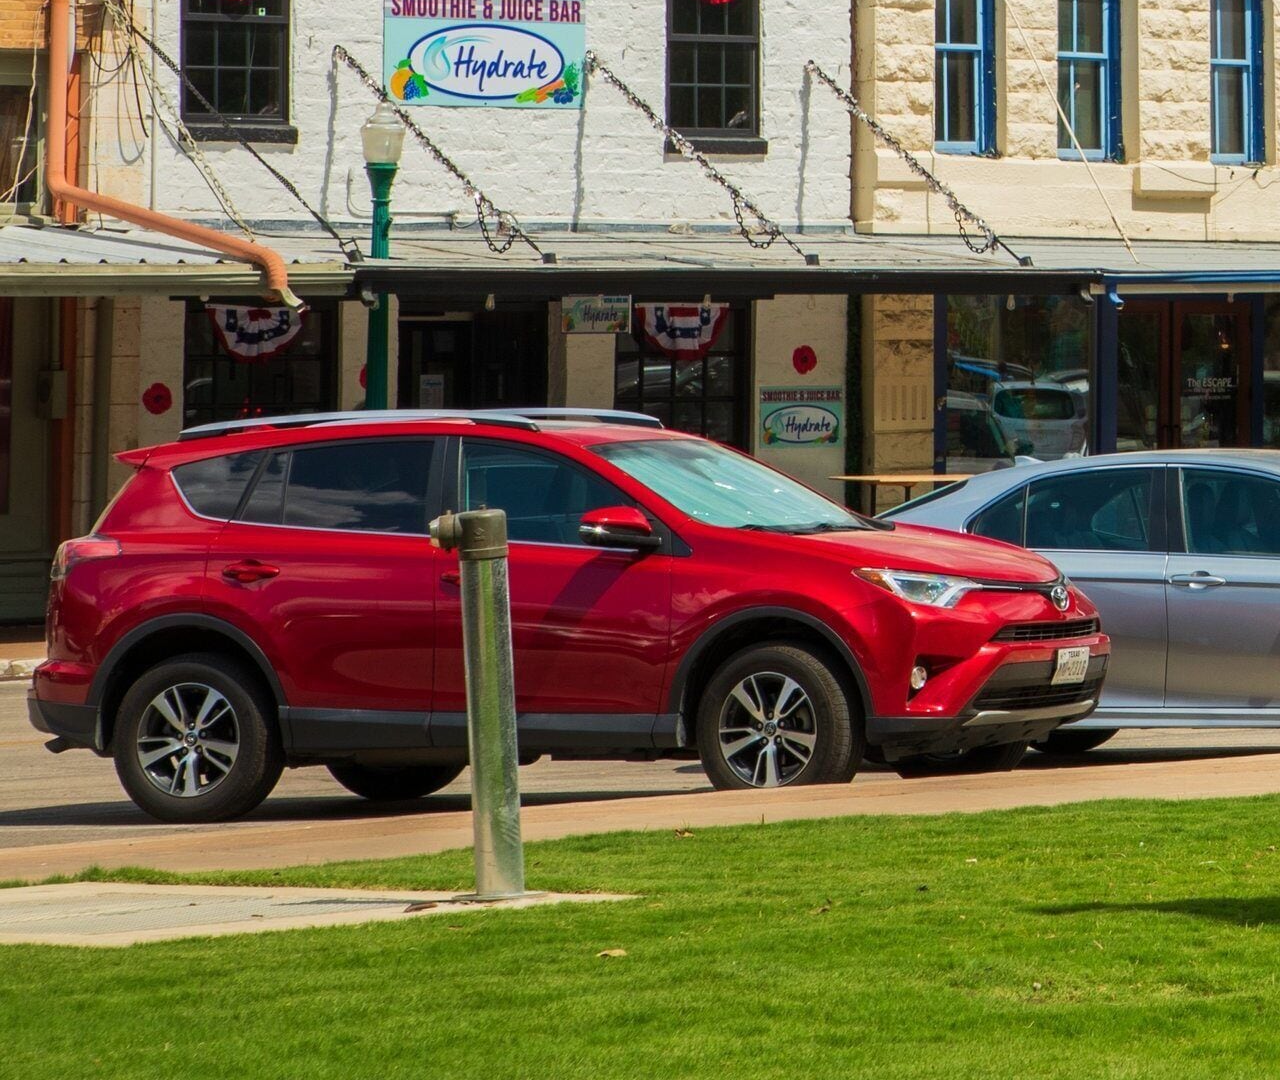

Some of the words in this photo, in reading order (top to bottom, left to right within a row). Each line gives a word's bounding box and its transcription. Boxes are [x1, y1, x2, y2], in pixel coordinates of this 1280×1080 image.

[550, 0, 581, 22] BAR
[454, 45, 548, 92] Hydrate
[584, 305, 618, 329] Hydrate
[1202, 377, 1233, 388] ESCAPE
[762, 391, 797, 401] SMOOTHIE
[827, 391, 840, 401] BAR
[785, 416, 831, 440] Hydrate
